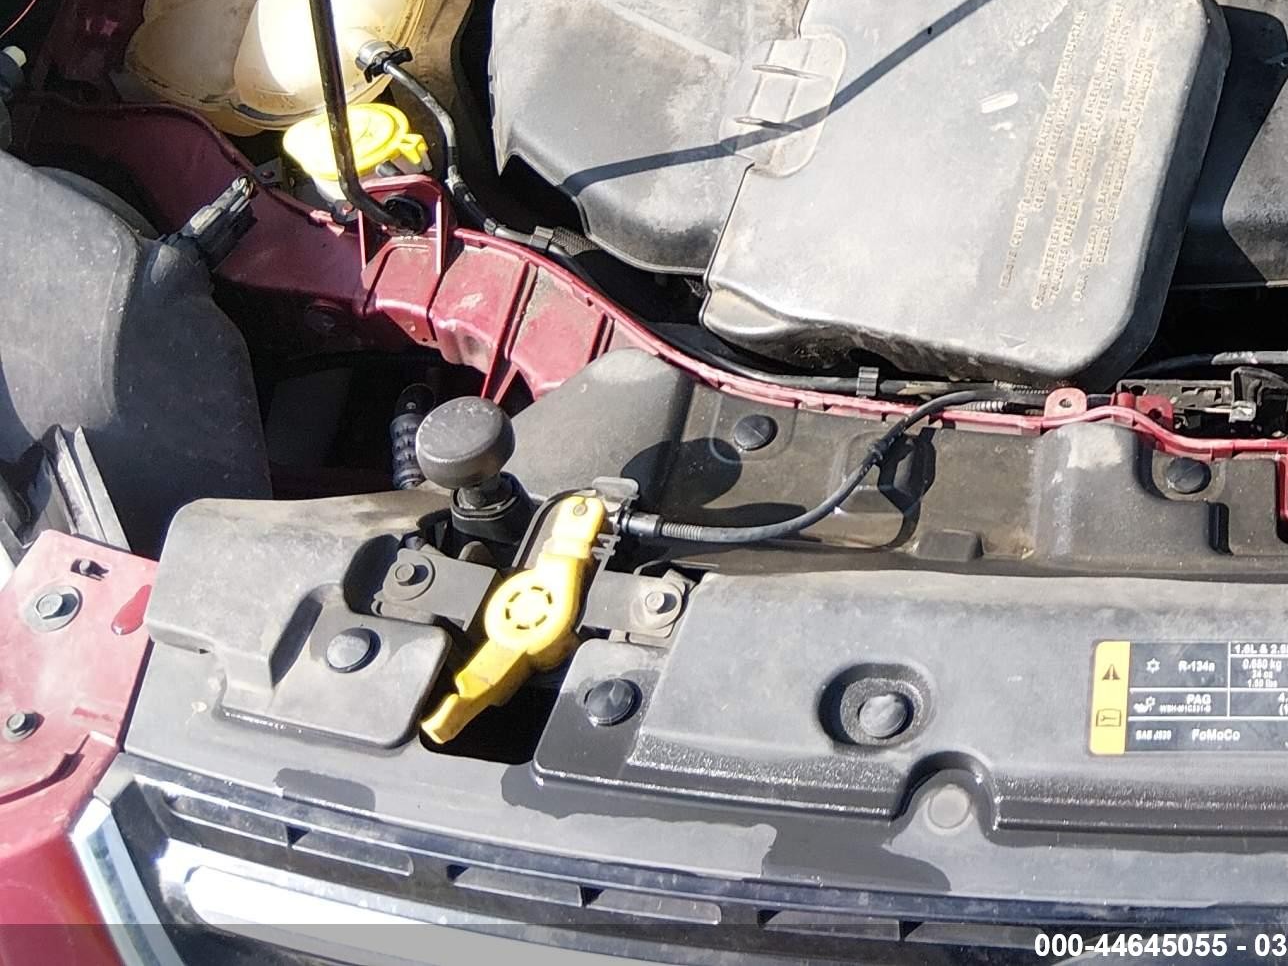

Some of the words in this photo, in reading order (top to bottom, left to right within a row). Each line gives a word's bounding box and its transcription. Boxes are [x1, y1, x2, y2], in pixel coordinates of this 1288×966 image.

[1044, 144, 1059, 175] AFTER
[1041, 216, 1066, 277] INTERVENIR
[1065, 175, 1075, 188] LA
[1085, 73, 1104, 115] ENLEVER
[1011, 215, 1028, 247] COVER
[1025, 152, 1044, 193] SERVICE
[1095, 207, 1104, 221] LA
[1063, 201, 1082, 243] REPOSER
[1178, 660, 1216, 672] R-134a
[1270, 658, 1282, 672] kg
[1186, 694, 1211, 704] PAG
[1191, 728, 1241, 741] FoMoCo
